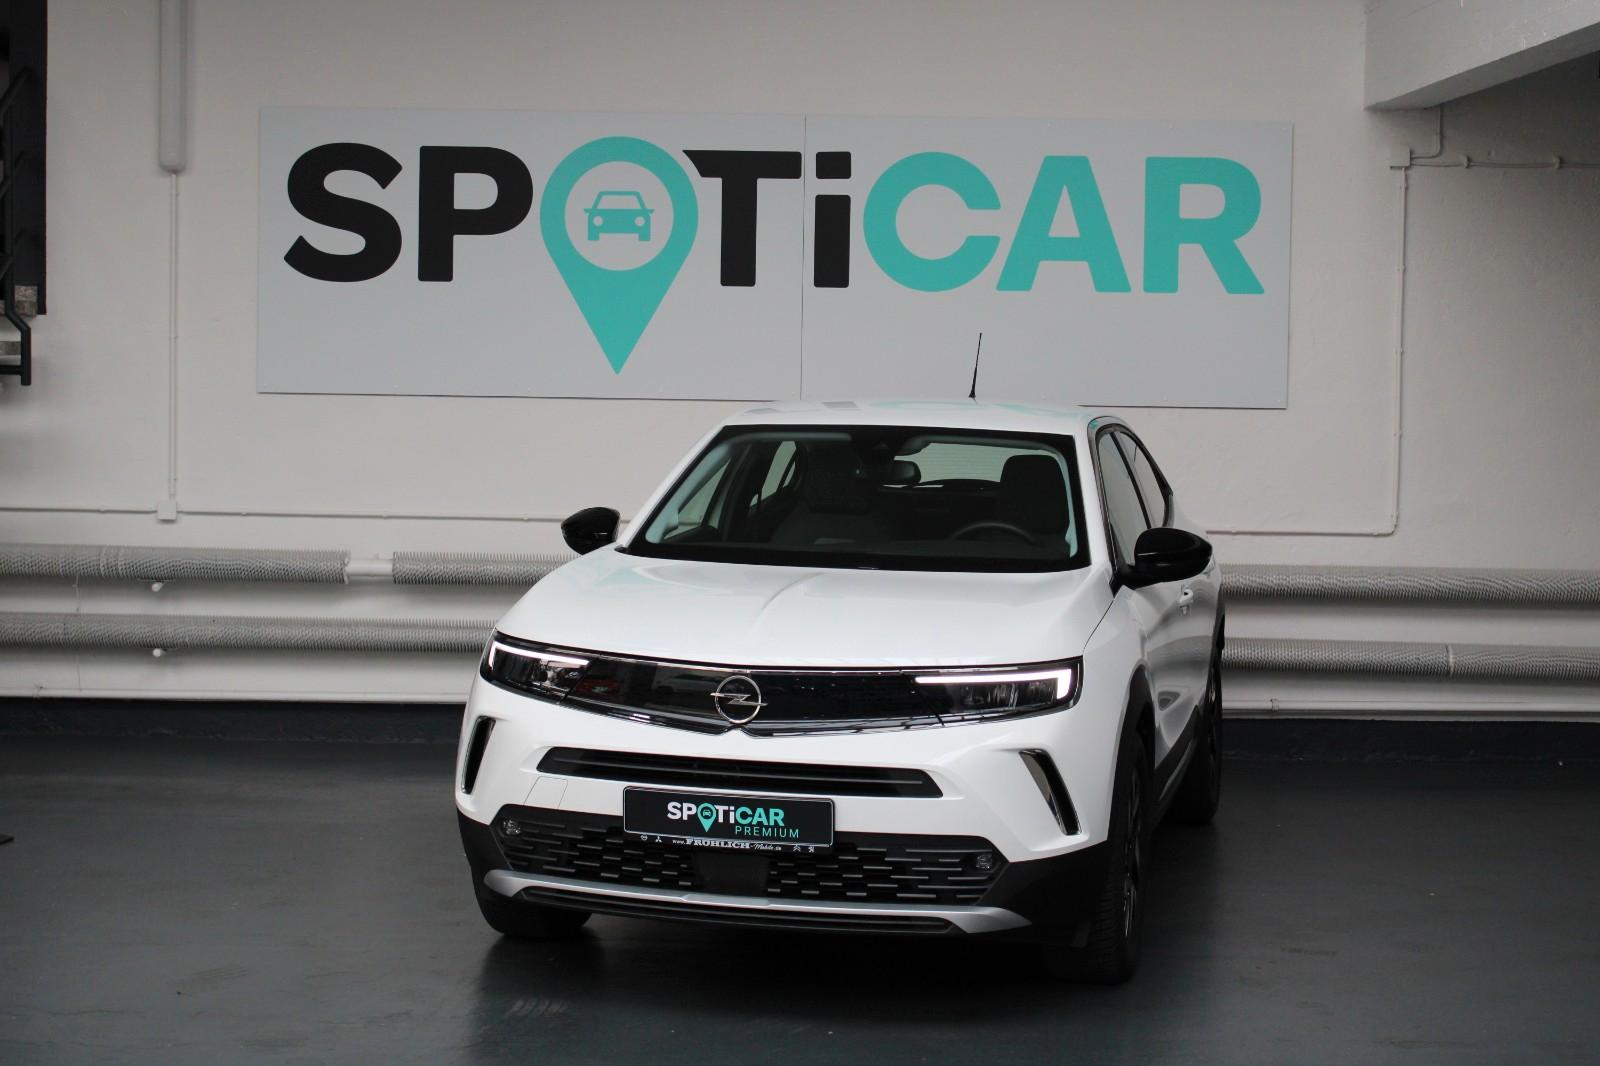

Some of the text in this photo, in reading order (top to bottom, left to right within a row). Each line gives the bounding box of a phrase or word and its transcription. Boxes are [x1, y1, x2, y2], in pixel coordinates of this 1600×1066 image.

[284, 136, 1265, 375] SPOTiCAR
[667, 800, 785, 833] SPOTiCAR
[735, 825, 799, 838] PREMIUM
